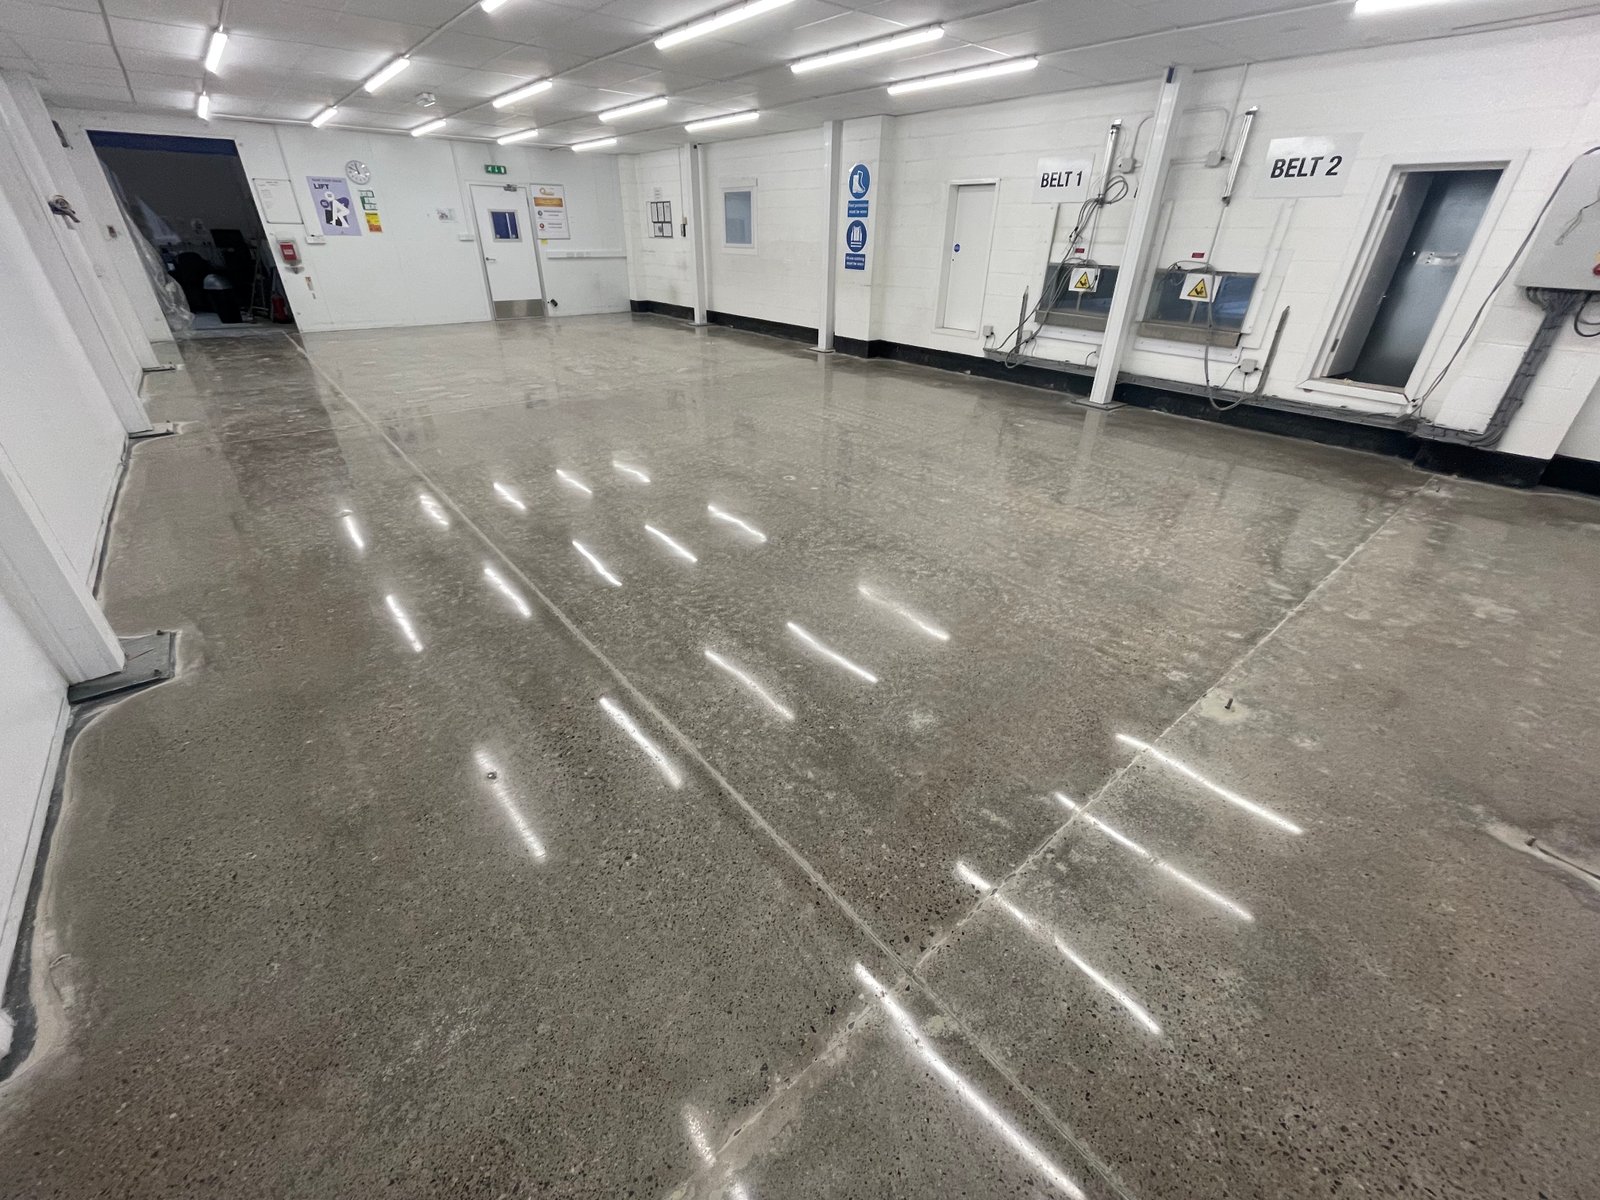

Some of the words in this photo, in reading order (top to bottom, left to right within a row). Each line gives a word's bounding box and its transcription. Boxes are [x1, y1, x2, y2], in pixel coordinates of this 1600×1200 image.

[1270, 156, 1324, 178] BELT
[1325, 155, 1343, 176] 2
[1040, 171, 1073, 188] BELT
[1076, 170, 1083, 187] 1
